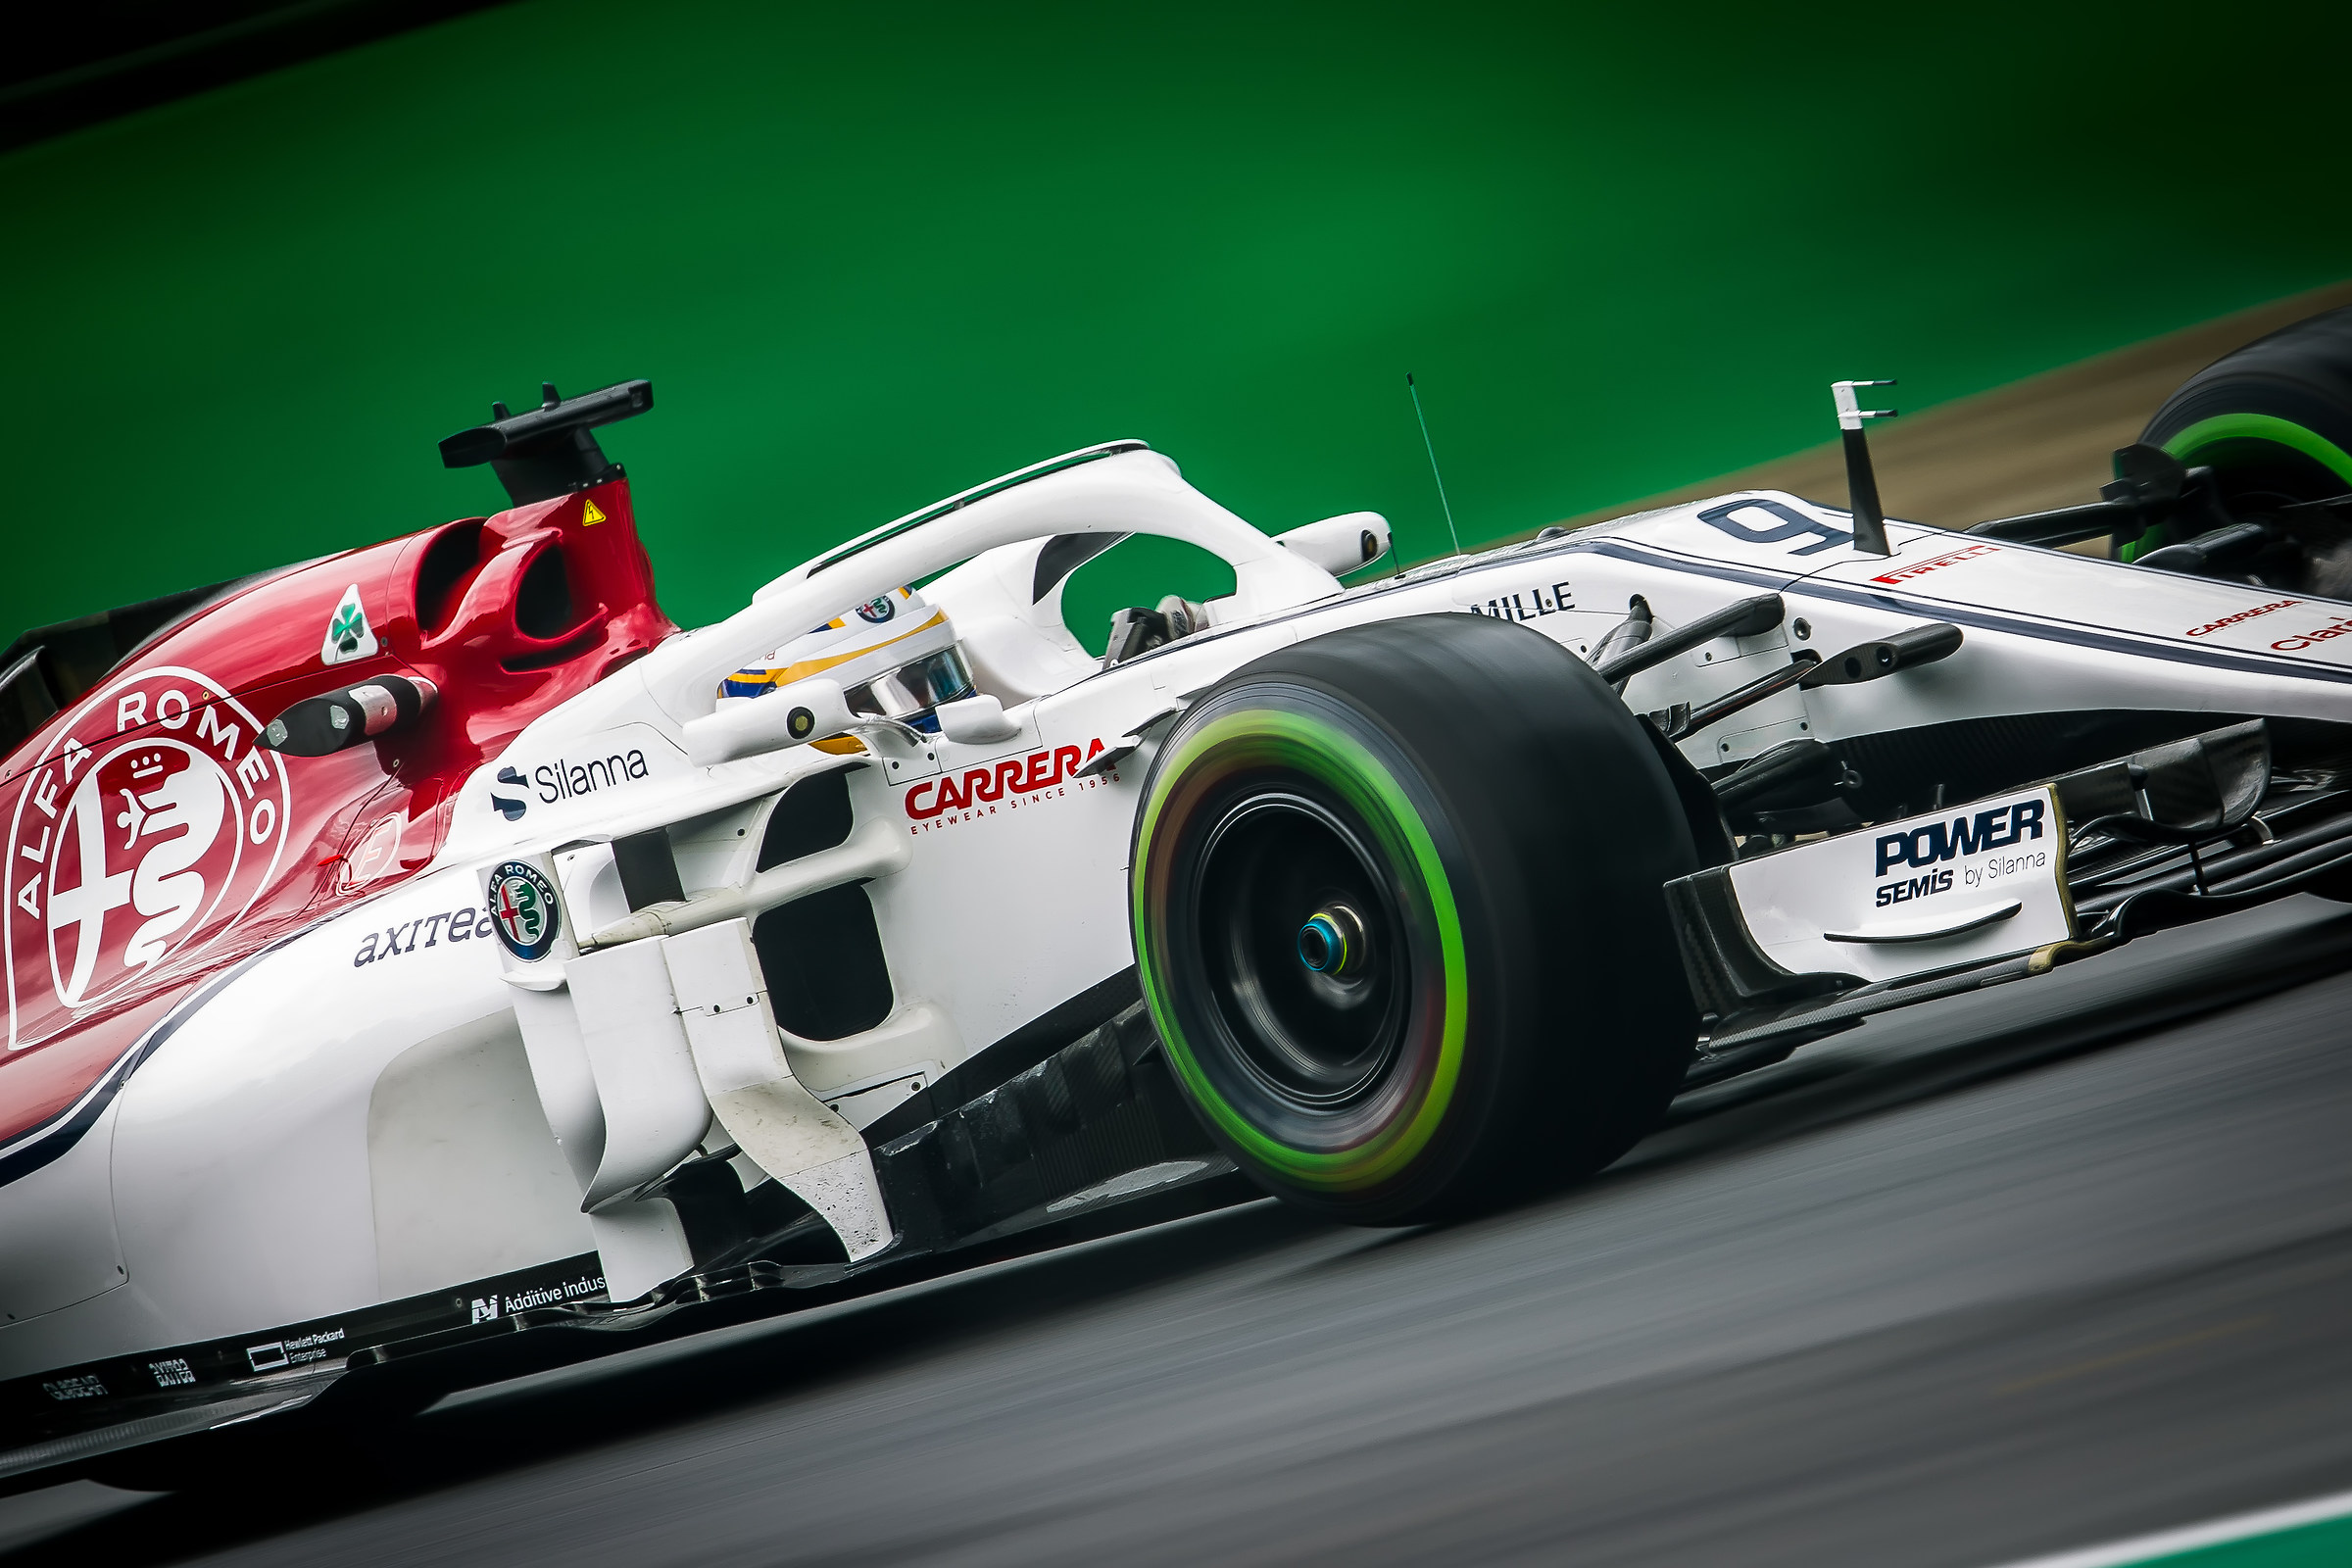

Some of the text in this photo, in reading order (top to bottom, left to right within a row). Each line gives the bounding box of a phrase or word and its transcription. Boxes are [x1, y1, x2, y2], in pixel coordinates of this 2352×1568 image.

[1697, 499, 1855, 556] 9
[1870, 545, 2002, 584] PIRELLI
[1471, 581, 1576, 621] MILLE
[2185, 600, 2303, 637] CARRERA
[2271, 618, 2352, 651] Clar
[535, 750, 649, 804] Silanna
[18, 689, 276, 919] ALFA ROMEO
[910, 773, 1120, 835] EYEWEAR SINCE 1956
[1876, 799, 2045, 878] POWER
[1965, 865, 1984, 888] by
[1988, 852, 2046, 879] Silanna
[490, 864, 554, 916] ALFA ROMEO
[505, 1288, 562, 1313] Additive
[284, 1328, 345, 1350] Hewlett Packard
[289, 1348, 327, 1363] Enterprise
